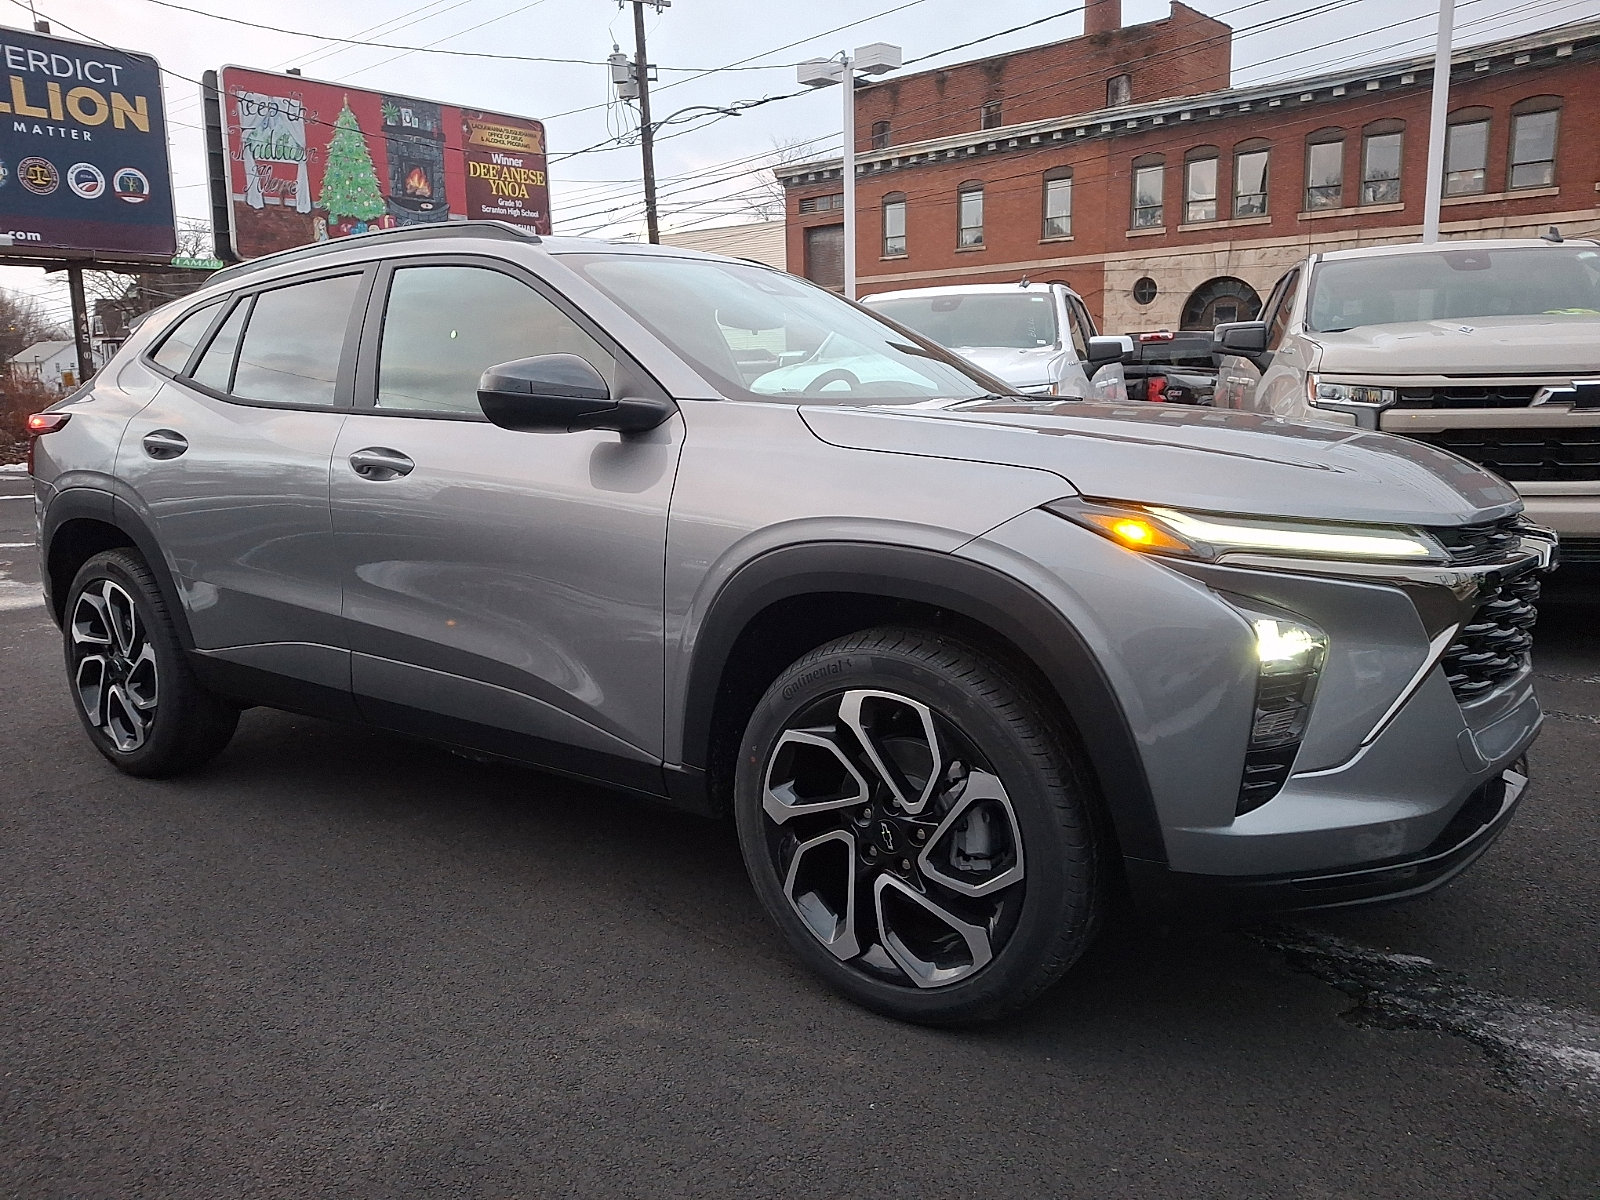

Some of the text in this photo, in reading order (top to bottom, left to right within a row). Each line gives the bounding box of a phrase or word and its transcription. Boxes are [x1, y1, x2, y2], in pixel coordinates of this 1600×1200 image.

[0, 43, 122, 86] ERDICT
[229, 84, 279, 117] Keep
[13, 121, 92, 141] MATTER
[487, 132, 503, 140] OFFICE
[228, 125, 318, 163] Tradition
[485, 137, 506, 146] ALCOHOL
[491, 153, 524, 167] Winner
[468, 161, 546, 186] DEE'ANESE
[488, 179, 530, 199] YNOA
[481, 204, 539, 218] Scranton High School
[498, 198, 515, 207] Grade
[782, 660, 842, 700] Continental
